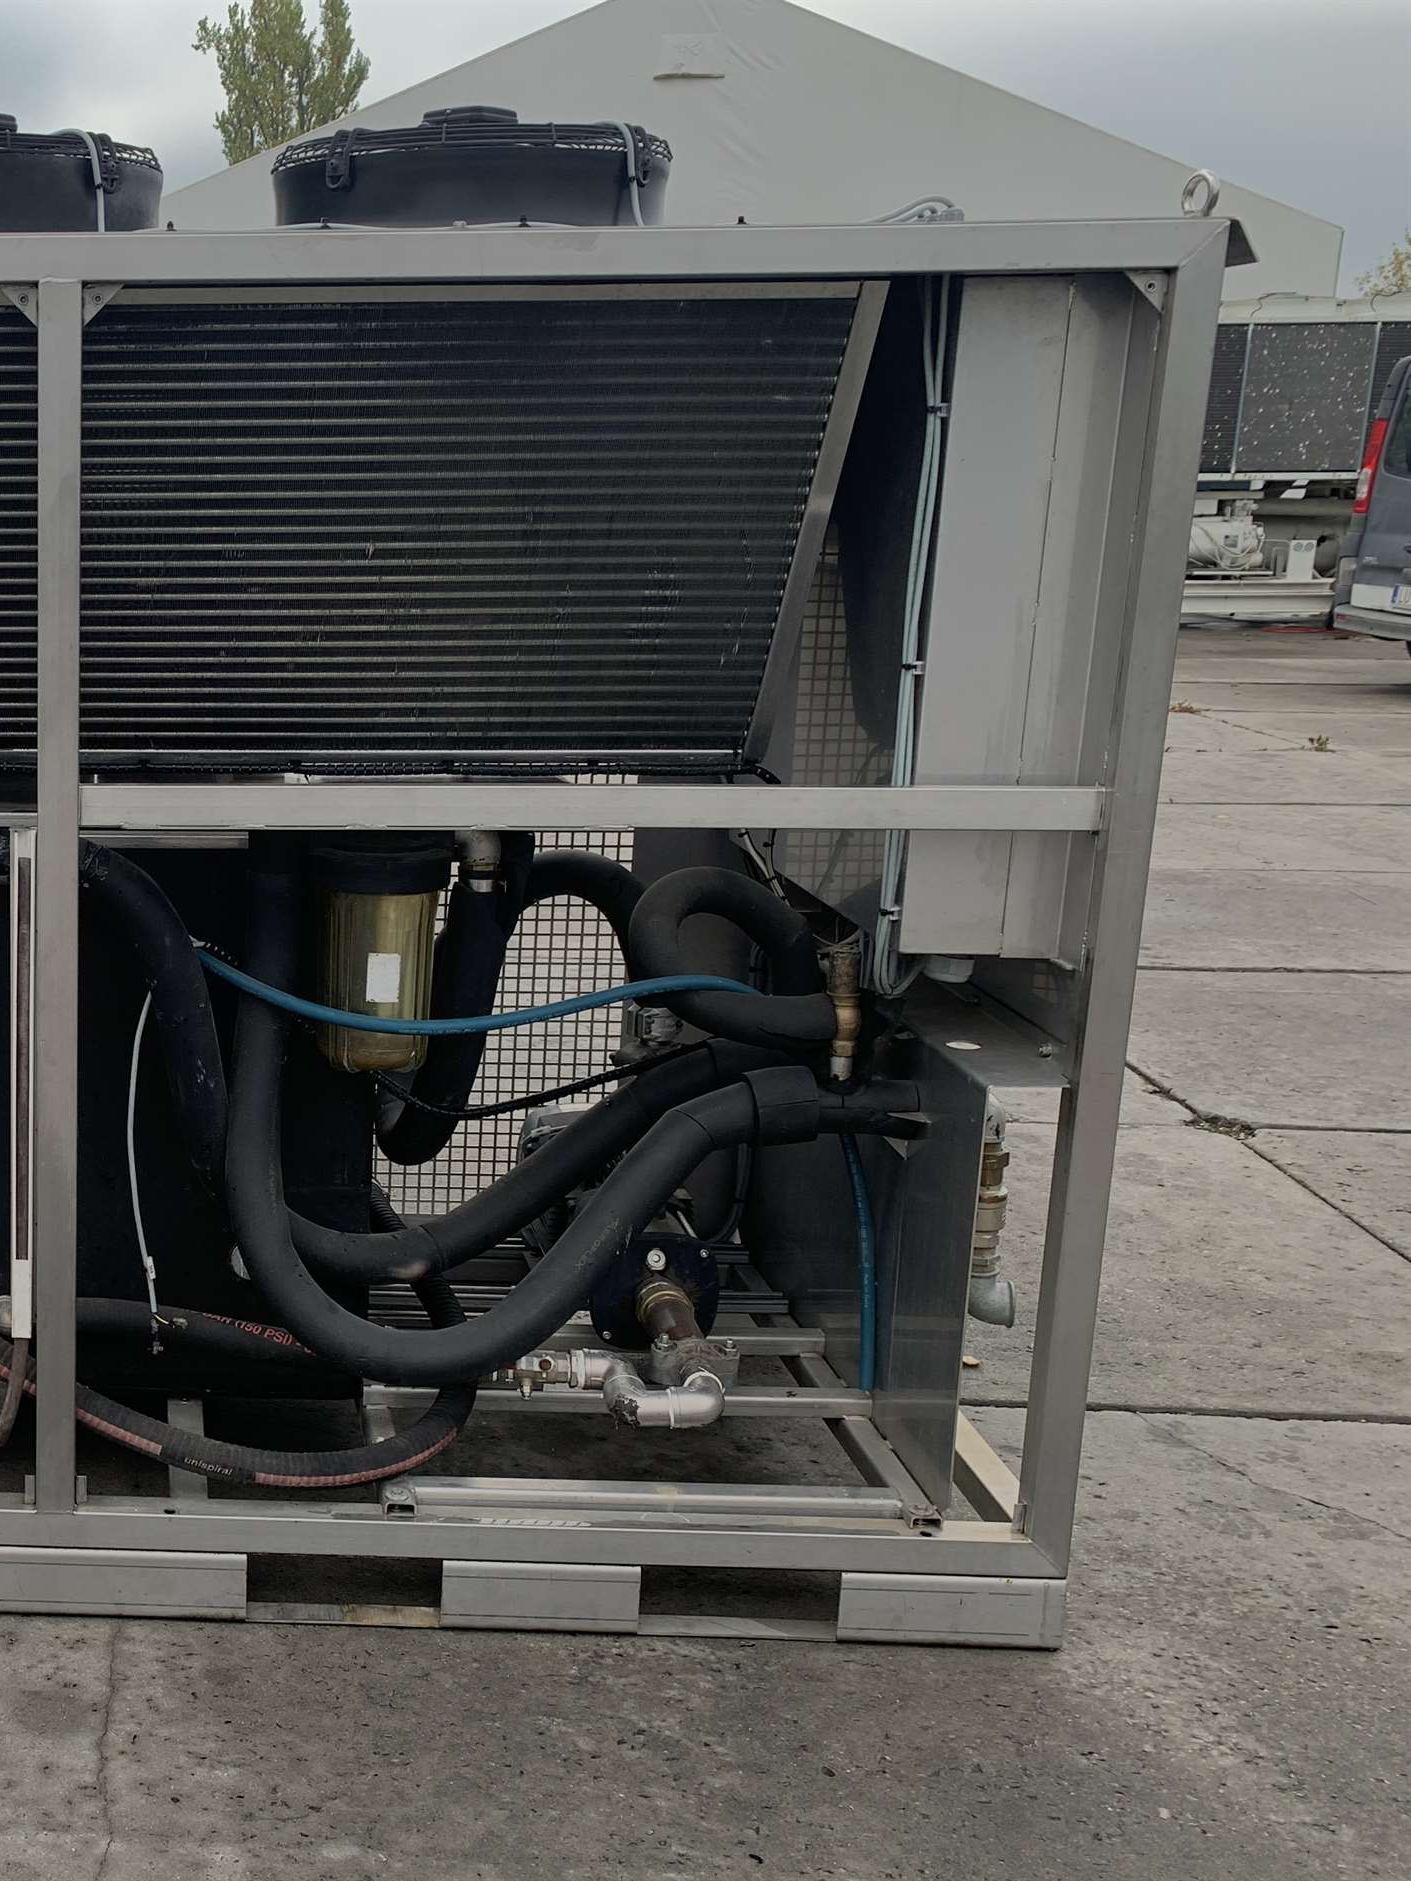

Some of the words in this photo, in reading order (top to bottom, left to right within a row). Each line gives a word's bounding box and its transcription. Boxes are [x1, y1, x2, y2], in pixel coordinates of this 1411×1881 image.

[235, 1320, 262, 1336] (150
[264, 1327, 294, 1346] PSI)
[184, 1456, 234, 1476] unispiral
